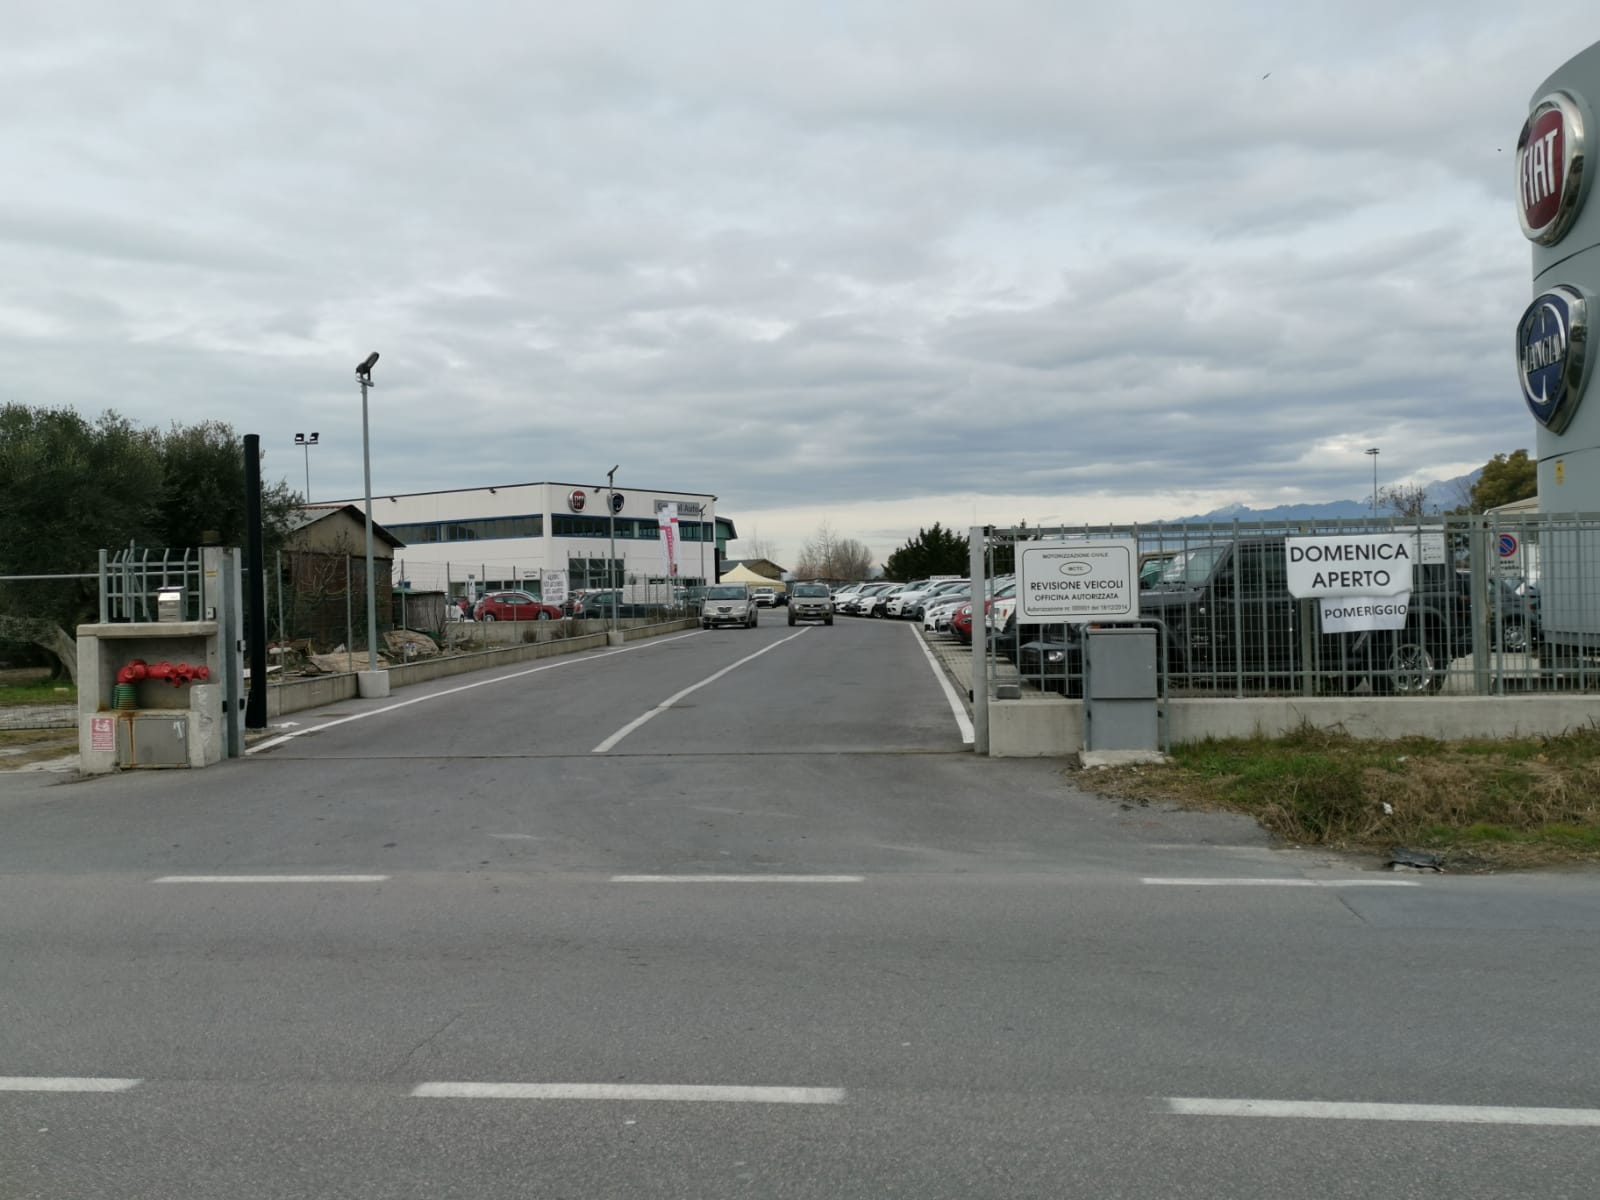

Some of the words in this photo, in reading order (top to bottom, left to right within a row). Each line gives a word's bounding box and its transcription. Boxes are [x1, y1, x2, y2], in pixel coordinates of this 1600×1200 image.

[1522, 128, 1558, 210] FIAT
[1290, 543, 1409, 563] DOMENICA
[1030, 580, 1081, 591] REVISIONE
[1084, 579, 1123, 589] VEICOLI
[1311, 570, 1391, 588] APERTO
[1034, 594, 1070, 602] OFFICINA
[1071, 593, 1119, 601] AUTORIZZATA
[1324, 604, 1407, 619] POMERIGGIO
